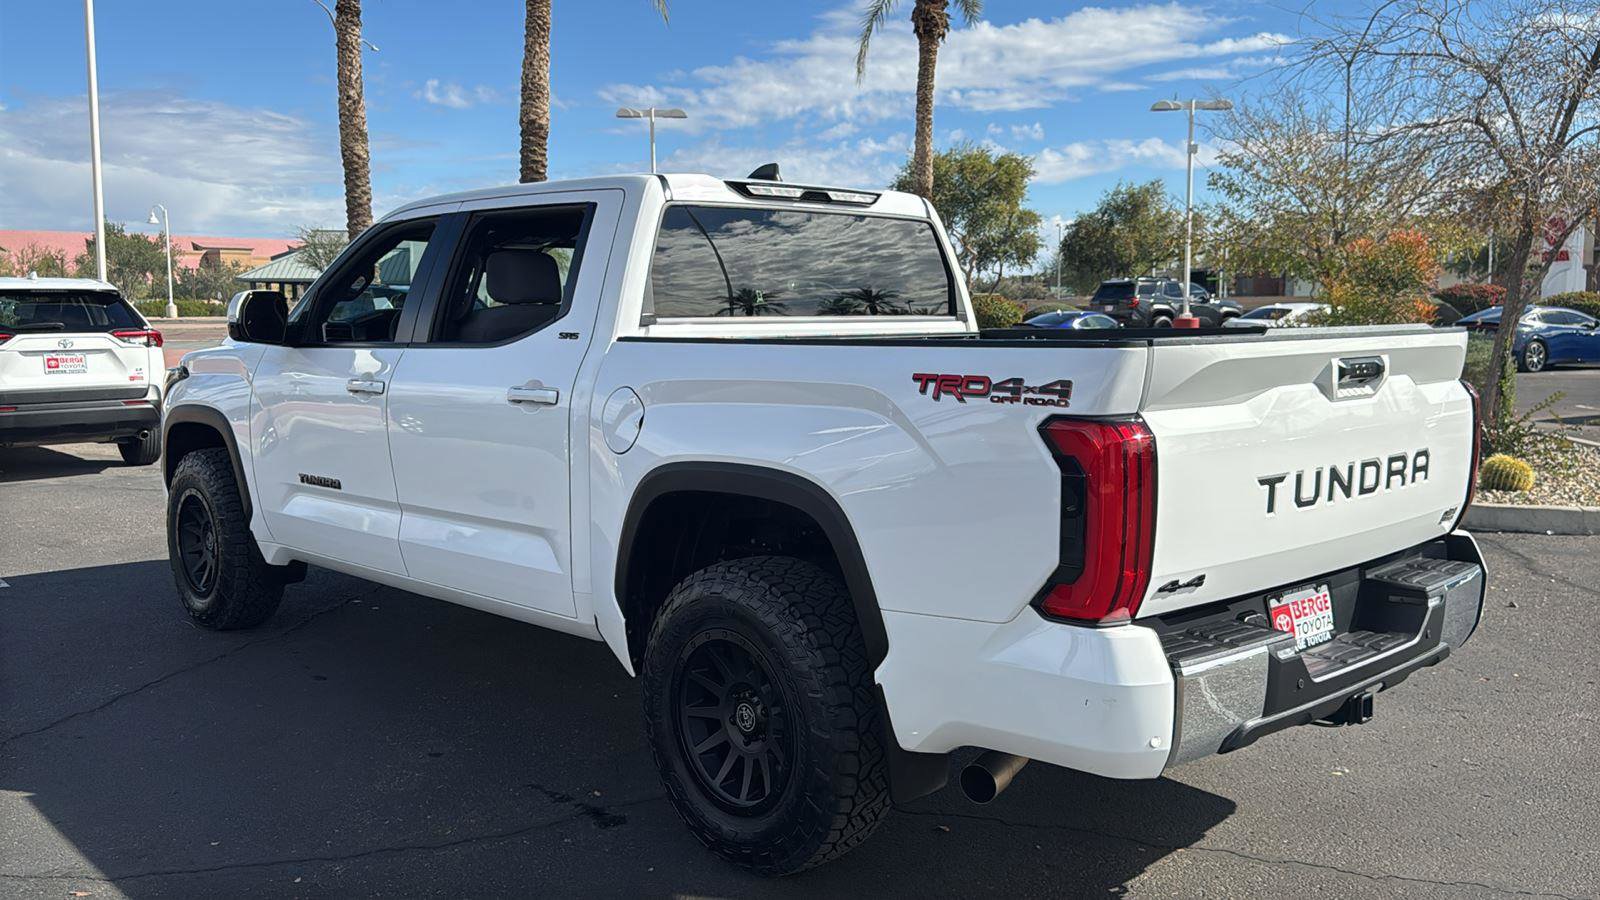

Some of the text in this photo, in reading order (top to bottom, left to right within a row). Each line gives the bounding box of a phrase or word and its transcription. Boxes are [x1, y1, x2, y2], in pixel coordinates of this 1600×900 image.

[912, 373, 994, 404] TRD
[990, 395, 1071, 408] OFF ROAD
[298, 473, 342, 490] TUNDRA
[1257, 447, 1431, 514] TUNDRA
[1291, 593, 1330, 620] BERGE
[1296, 614, 1334, 636] TOYOTA
[1306, 631, 1332, 647] TOYOTA
